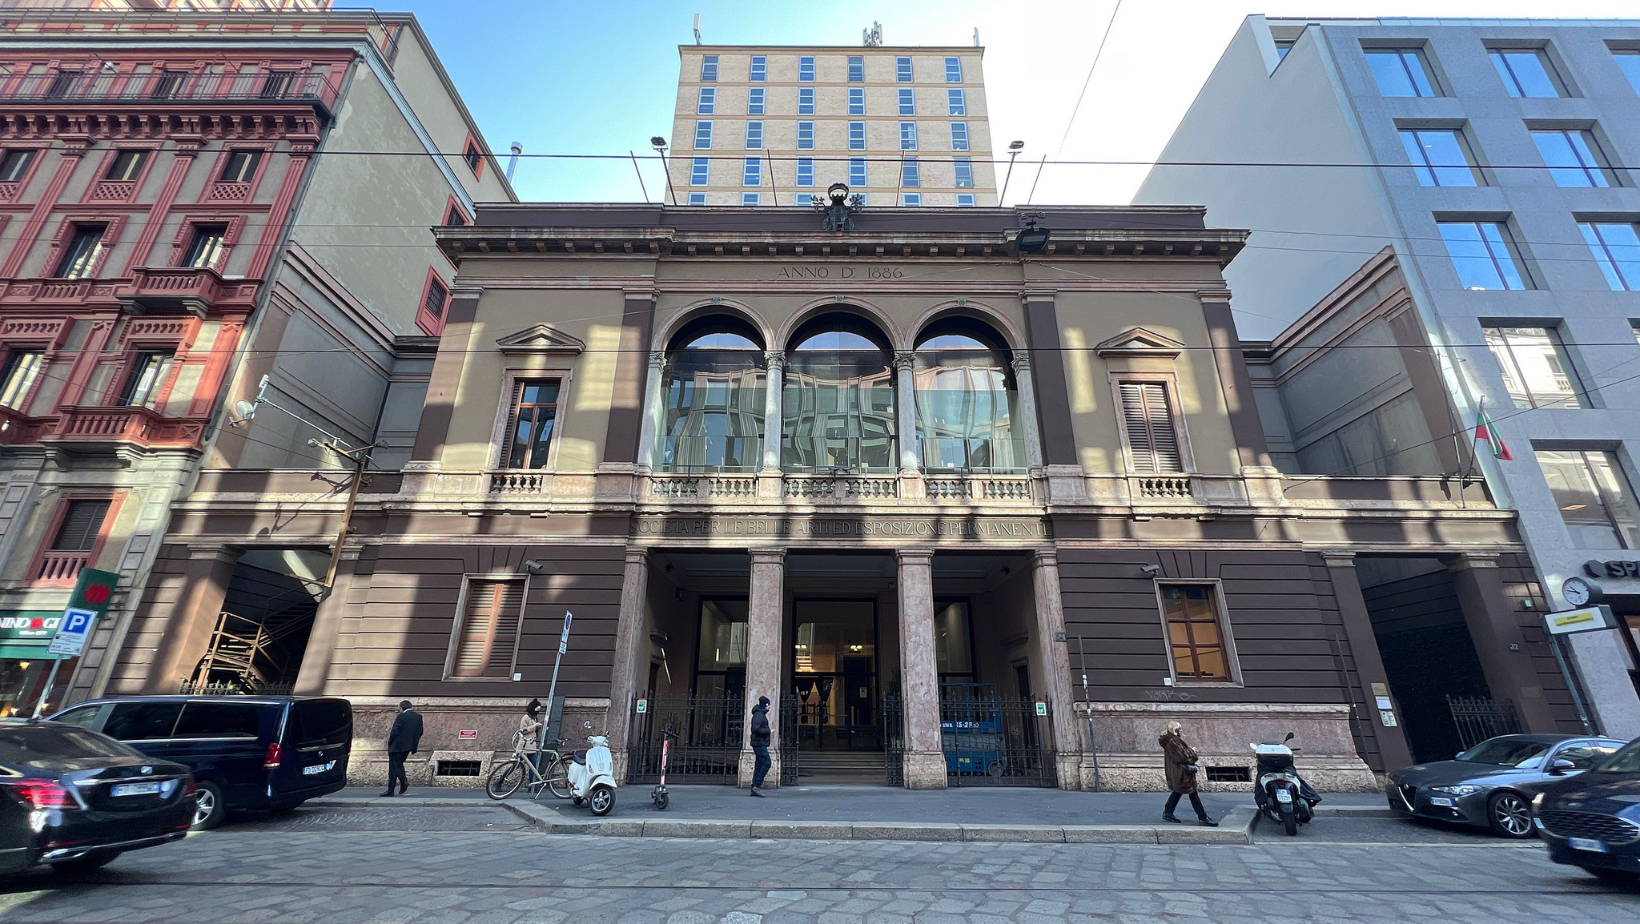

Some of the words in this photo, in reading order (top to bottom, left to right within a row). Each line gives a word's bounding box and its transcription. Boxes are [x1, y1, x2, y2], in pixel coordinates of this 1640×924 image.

[778, 266, 829, 279] ANNO
[692, 520, 721, 534] PER
[724, 520, 743, 534] LE
[746, 520, 792, 534] BELLE
[796, 521, 829, 535] ARTI
[832, 521, 852, 535] ED
[855, 521, 947, 536] ESPOSIZIONE
[949, 522, 1053, 536] PERMANENTE
[68, 614, 85, 631] P
